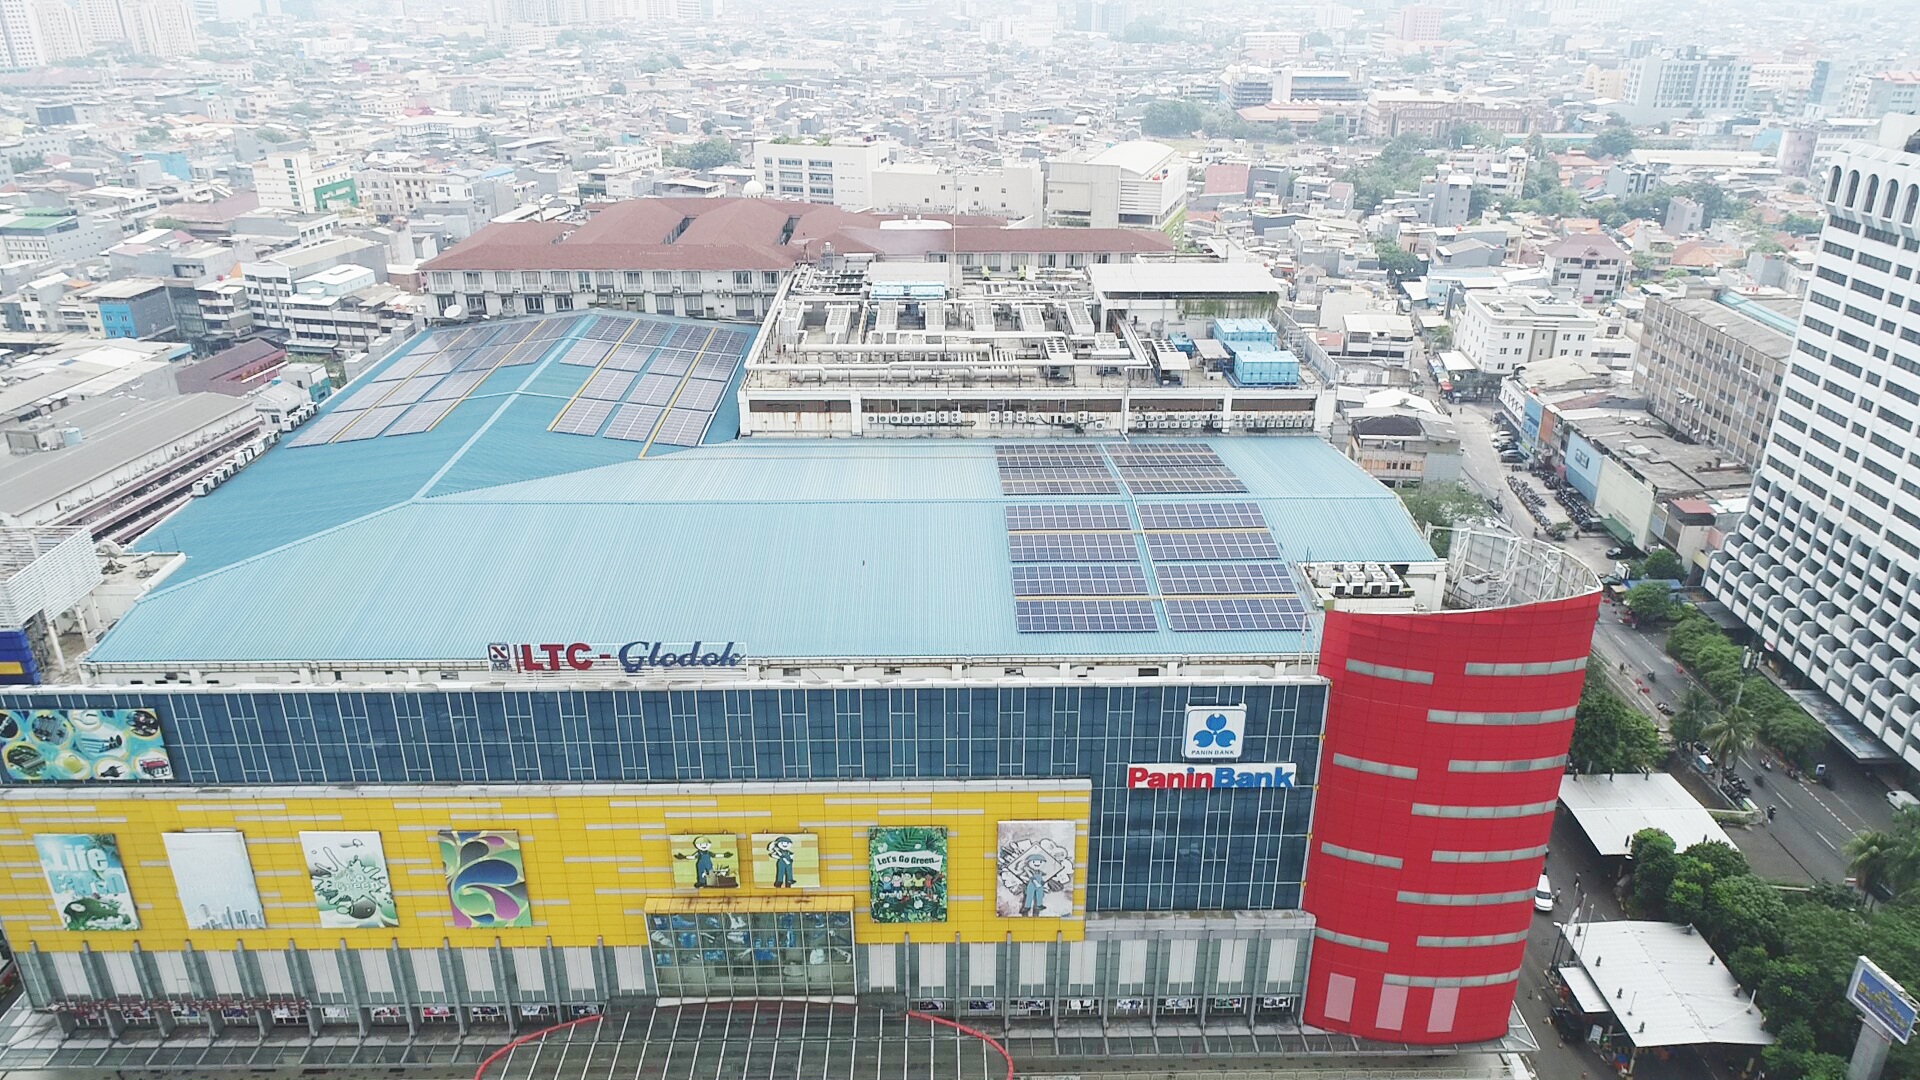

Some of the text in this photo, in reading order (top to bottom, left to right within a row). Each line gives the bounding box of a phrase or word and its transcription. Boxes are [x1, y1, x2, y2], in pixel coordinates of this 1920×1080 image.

[522, 643, 593, 671] LTC
[619, 641, 746, 673] Glodok
[47, 844, 109, 872] Life
[877, 856, 897, 865] Let's
[899, 855, 909, 863] Go
